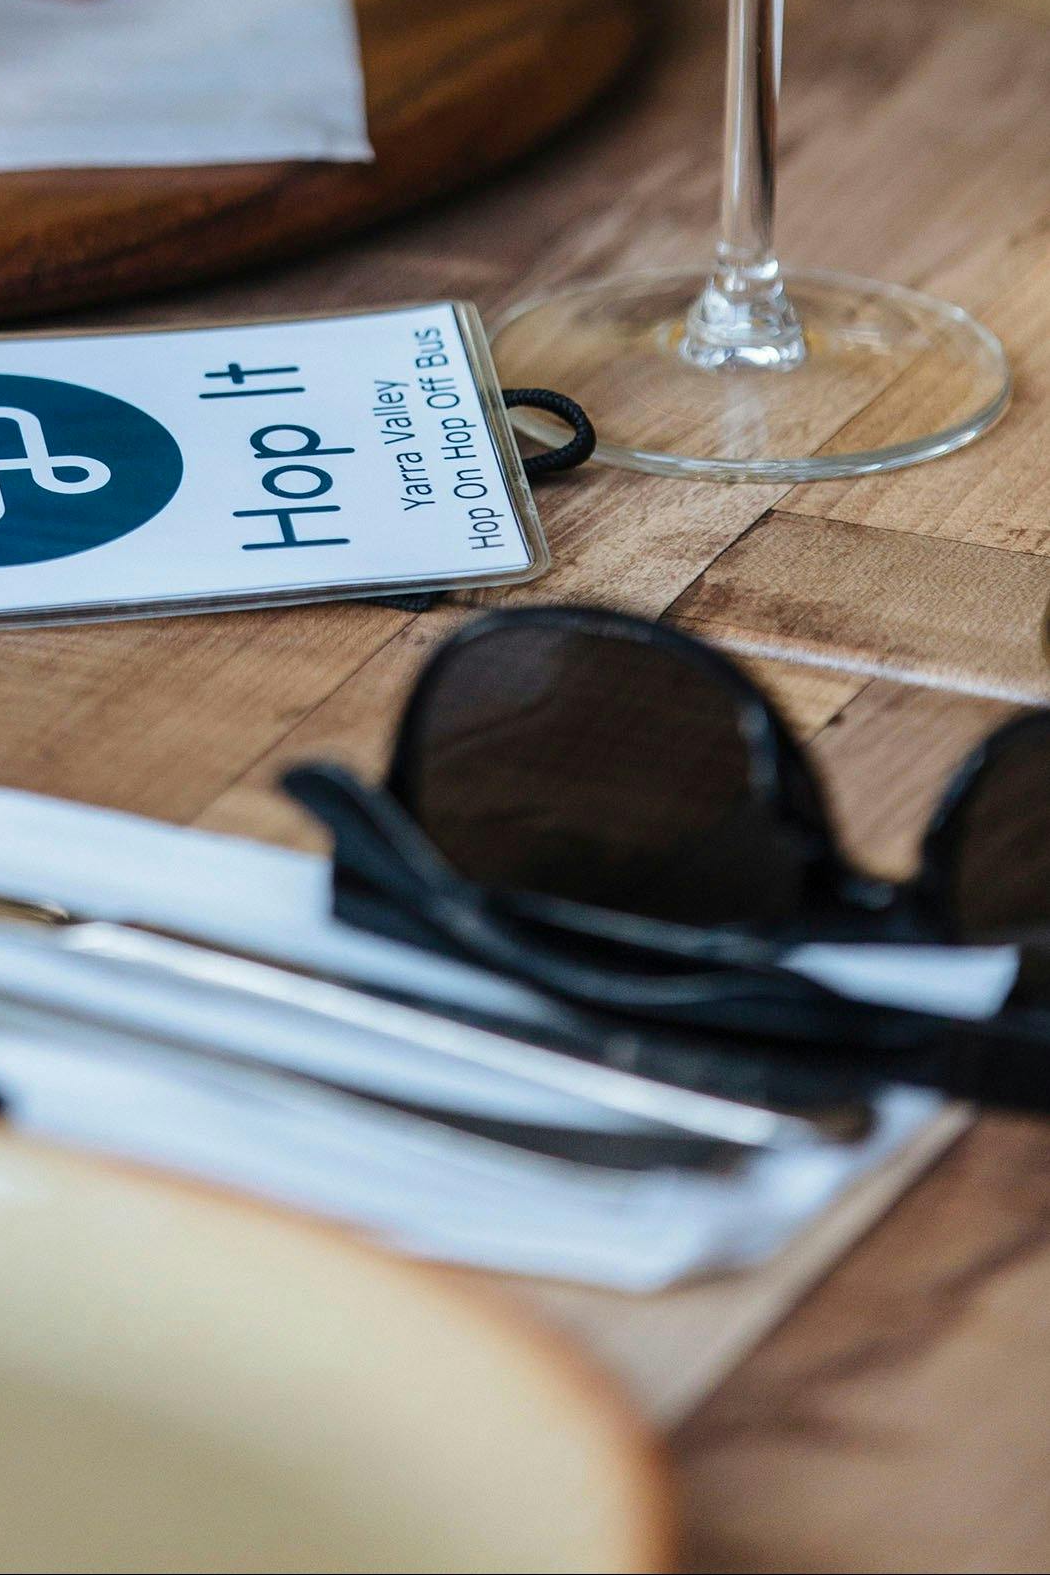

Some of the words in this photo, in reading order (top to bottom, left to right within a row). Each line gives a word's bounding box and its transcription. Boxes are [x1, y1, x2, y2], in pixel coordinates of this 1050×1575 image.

[414, 327, 449, 370] Bus
[199, 362, 306, 399] It
[419, 377, 460, 409] Off
[373, 379, 415, 445] Valley
[441, 417, 477, 460] Hop
[232, 424, 355, 551] Hop
[396, 452, 435, 511] Yarra
[453, 469, 488, 499] On
[468, 507, 505, 550] Hop
